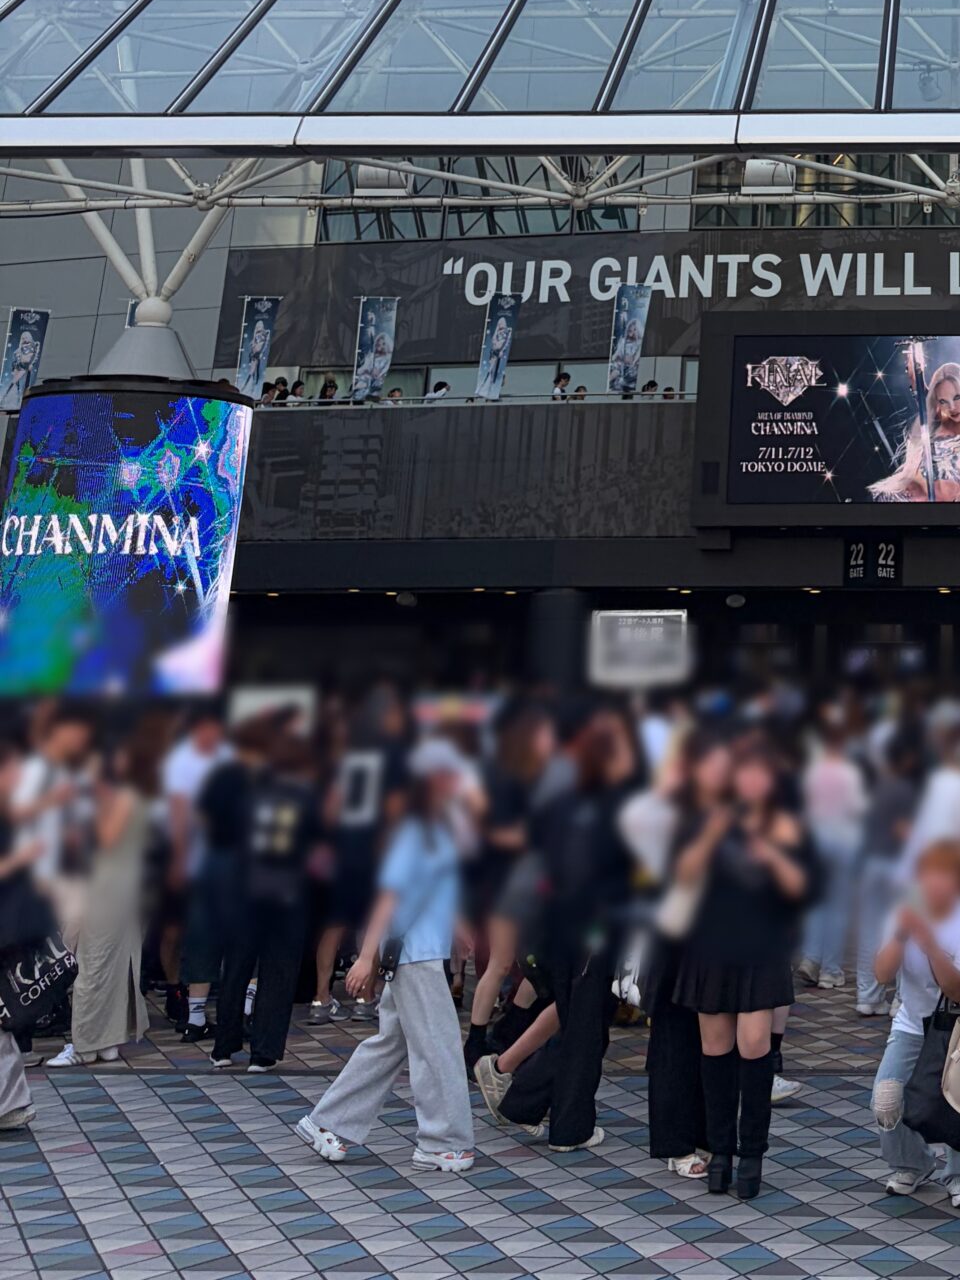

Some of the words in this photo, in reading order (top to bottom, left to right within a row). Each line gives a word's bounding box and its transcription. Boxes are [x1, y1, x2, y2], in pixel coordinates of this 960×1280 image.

[589, 253, 783, 301] GIANTS
[798, 252, 932, 297] WILL
[746, 360, 828, 388] FINAL
[750, 421, 819, 436] CHANMINA
[757, 447, 814, 459] 7/11.7/12
[739, 461, 785, 473] TOKYO
[787, 461, 827, 473] DOME
[2, 514, 202, 557] CHANMINA
[850, 543, 864, 566] 22
[878, 542, 895, 566] 22
[877, 567, 895, 578] GATE
[20, 962, 64, 1006] COFFEE
